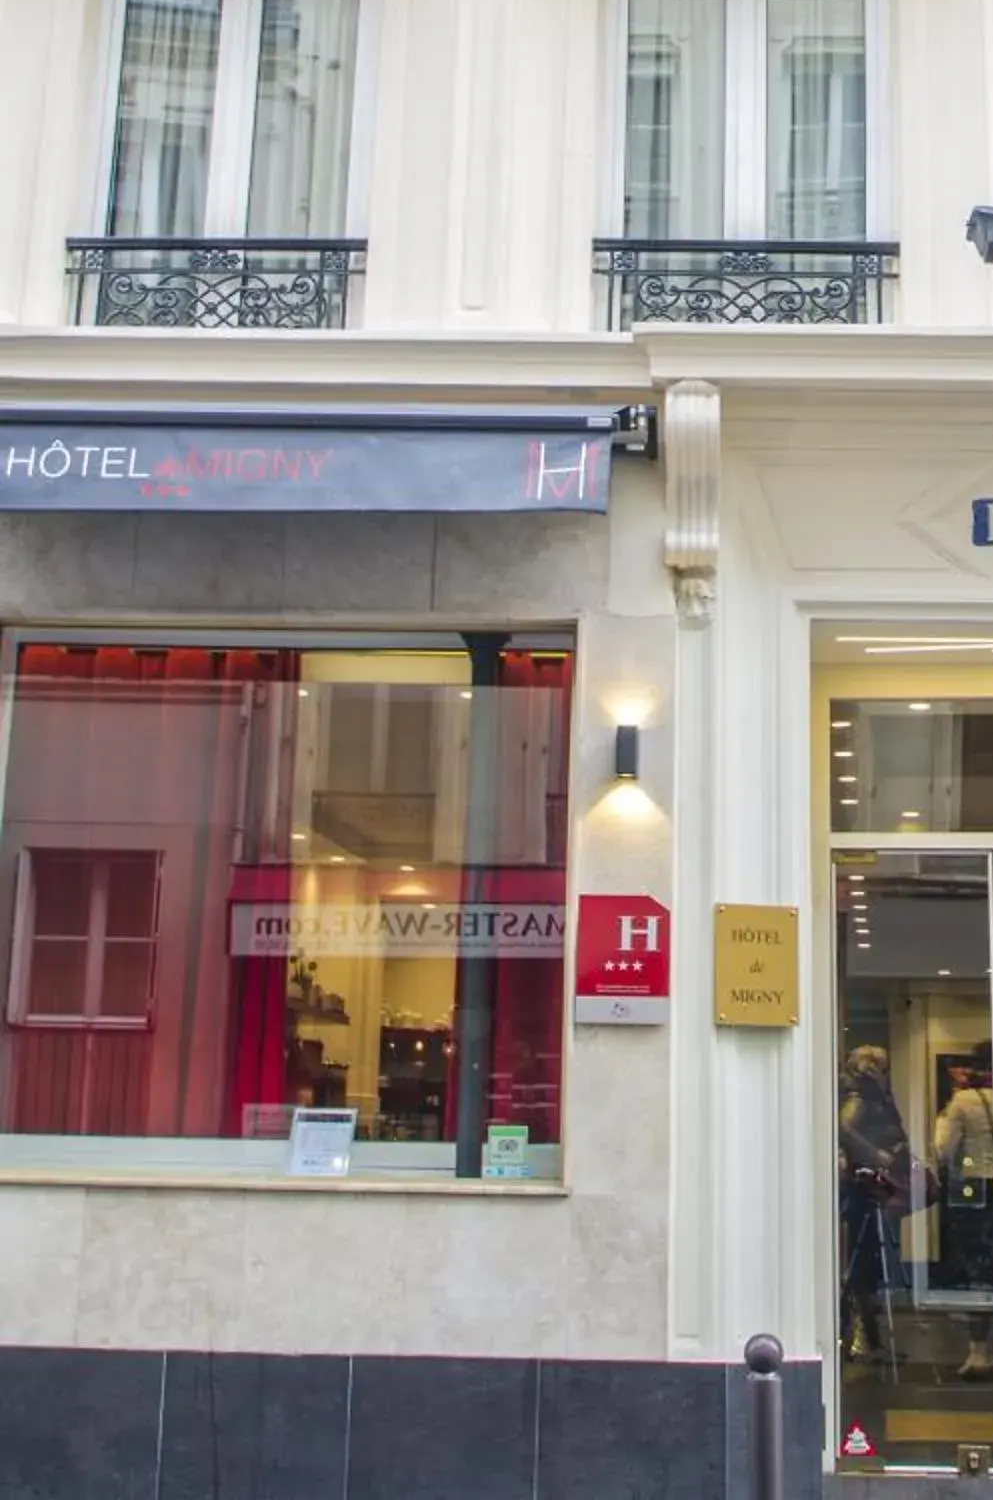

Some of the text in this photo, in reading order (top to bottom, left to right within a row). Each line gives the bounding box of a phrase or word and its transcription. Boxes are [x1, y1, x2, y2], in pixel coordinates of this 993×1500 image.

[5, 439, 151, 479] HÔTEL
[184, 446, 334, 481] MIGNY
[617, 914, 662, 953] H
[731, 927, 784, 946] HÔTEL
[749, 959, 765, 974] de
[730, 989, 785, 1005] MIGNY
